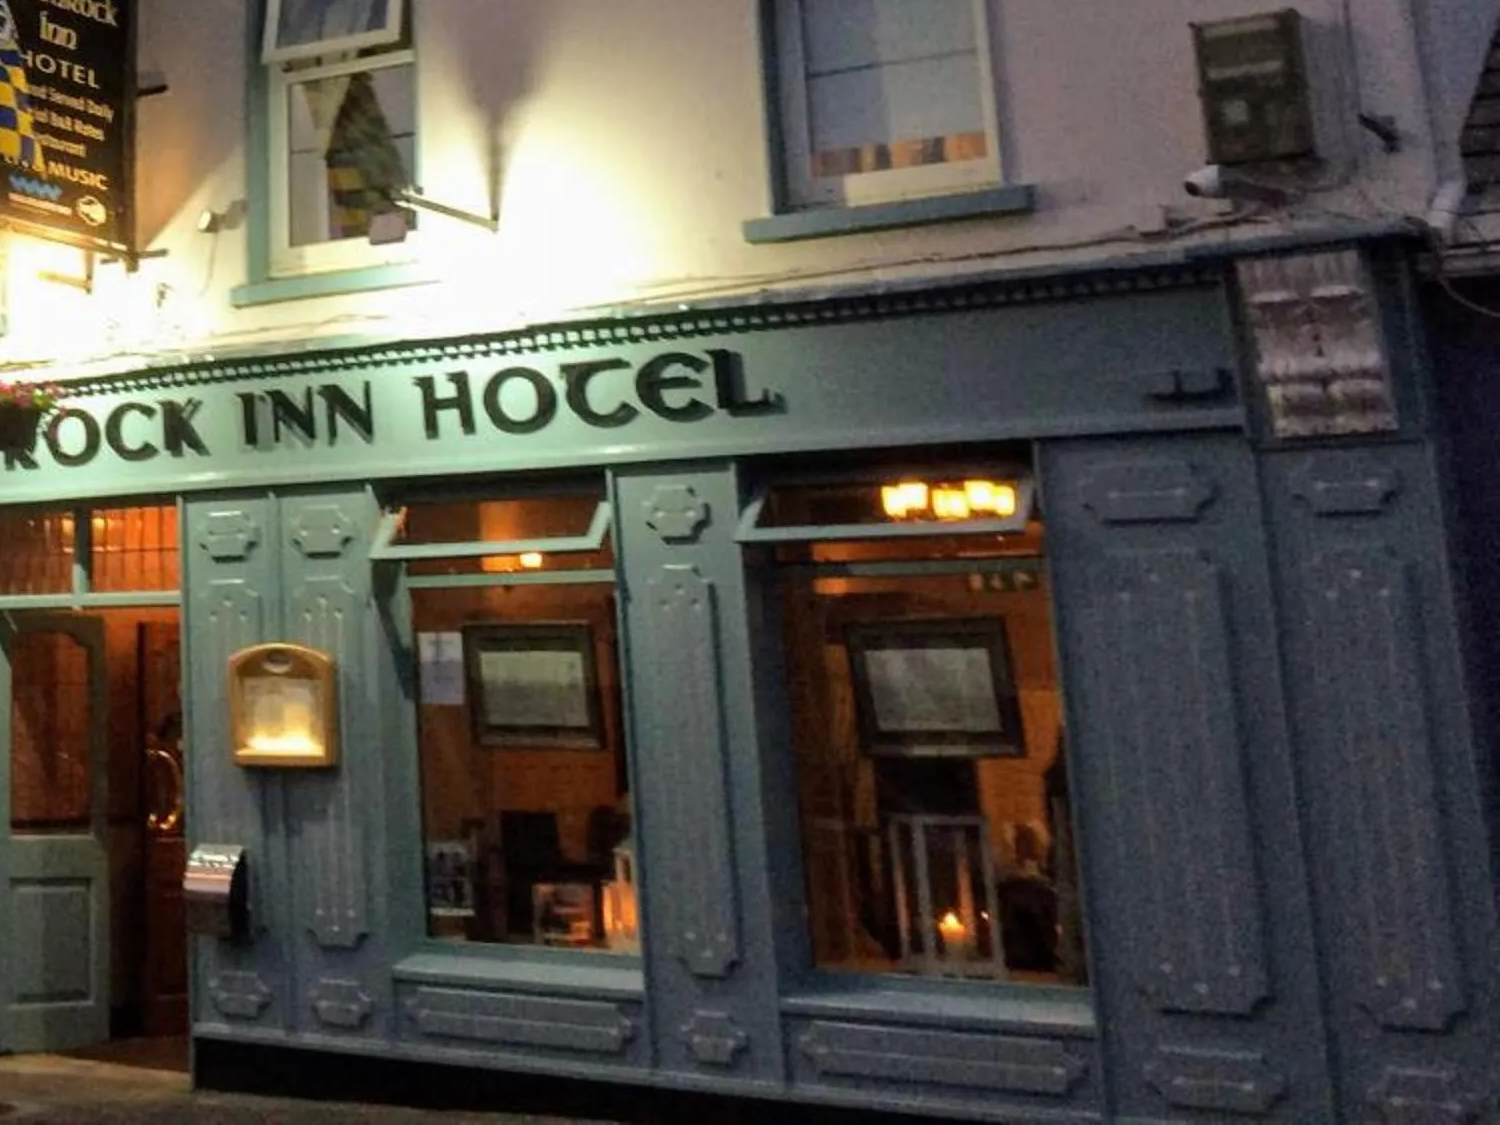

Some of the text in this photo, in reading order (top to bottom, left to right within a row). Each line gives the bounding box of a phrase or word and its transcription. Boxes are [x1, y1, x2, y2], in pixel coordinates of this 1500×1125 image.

[47, 159, 108, 191] MUSIC
[236, 380, 375, 449] INN
[413, 347, 790, 441] HOTEL
